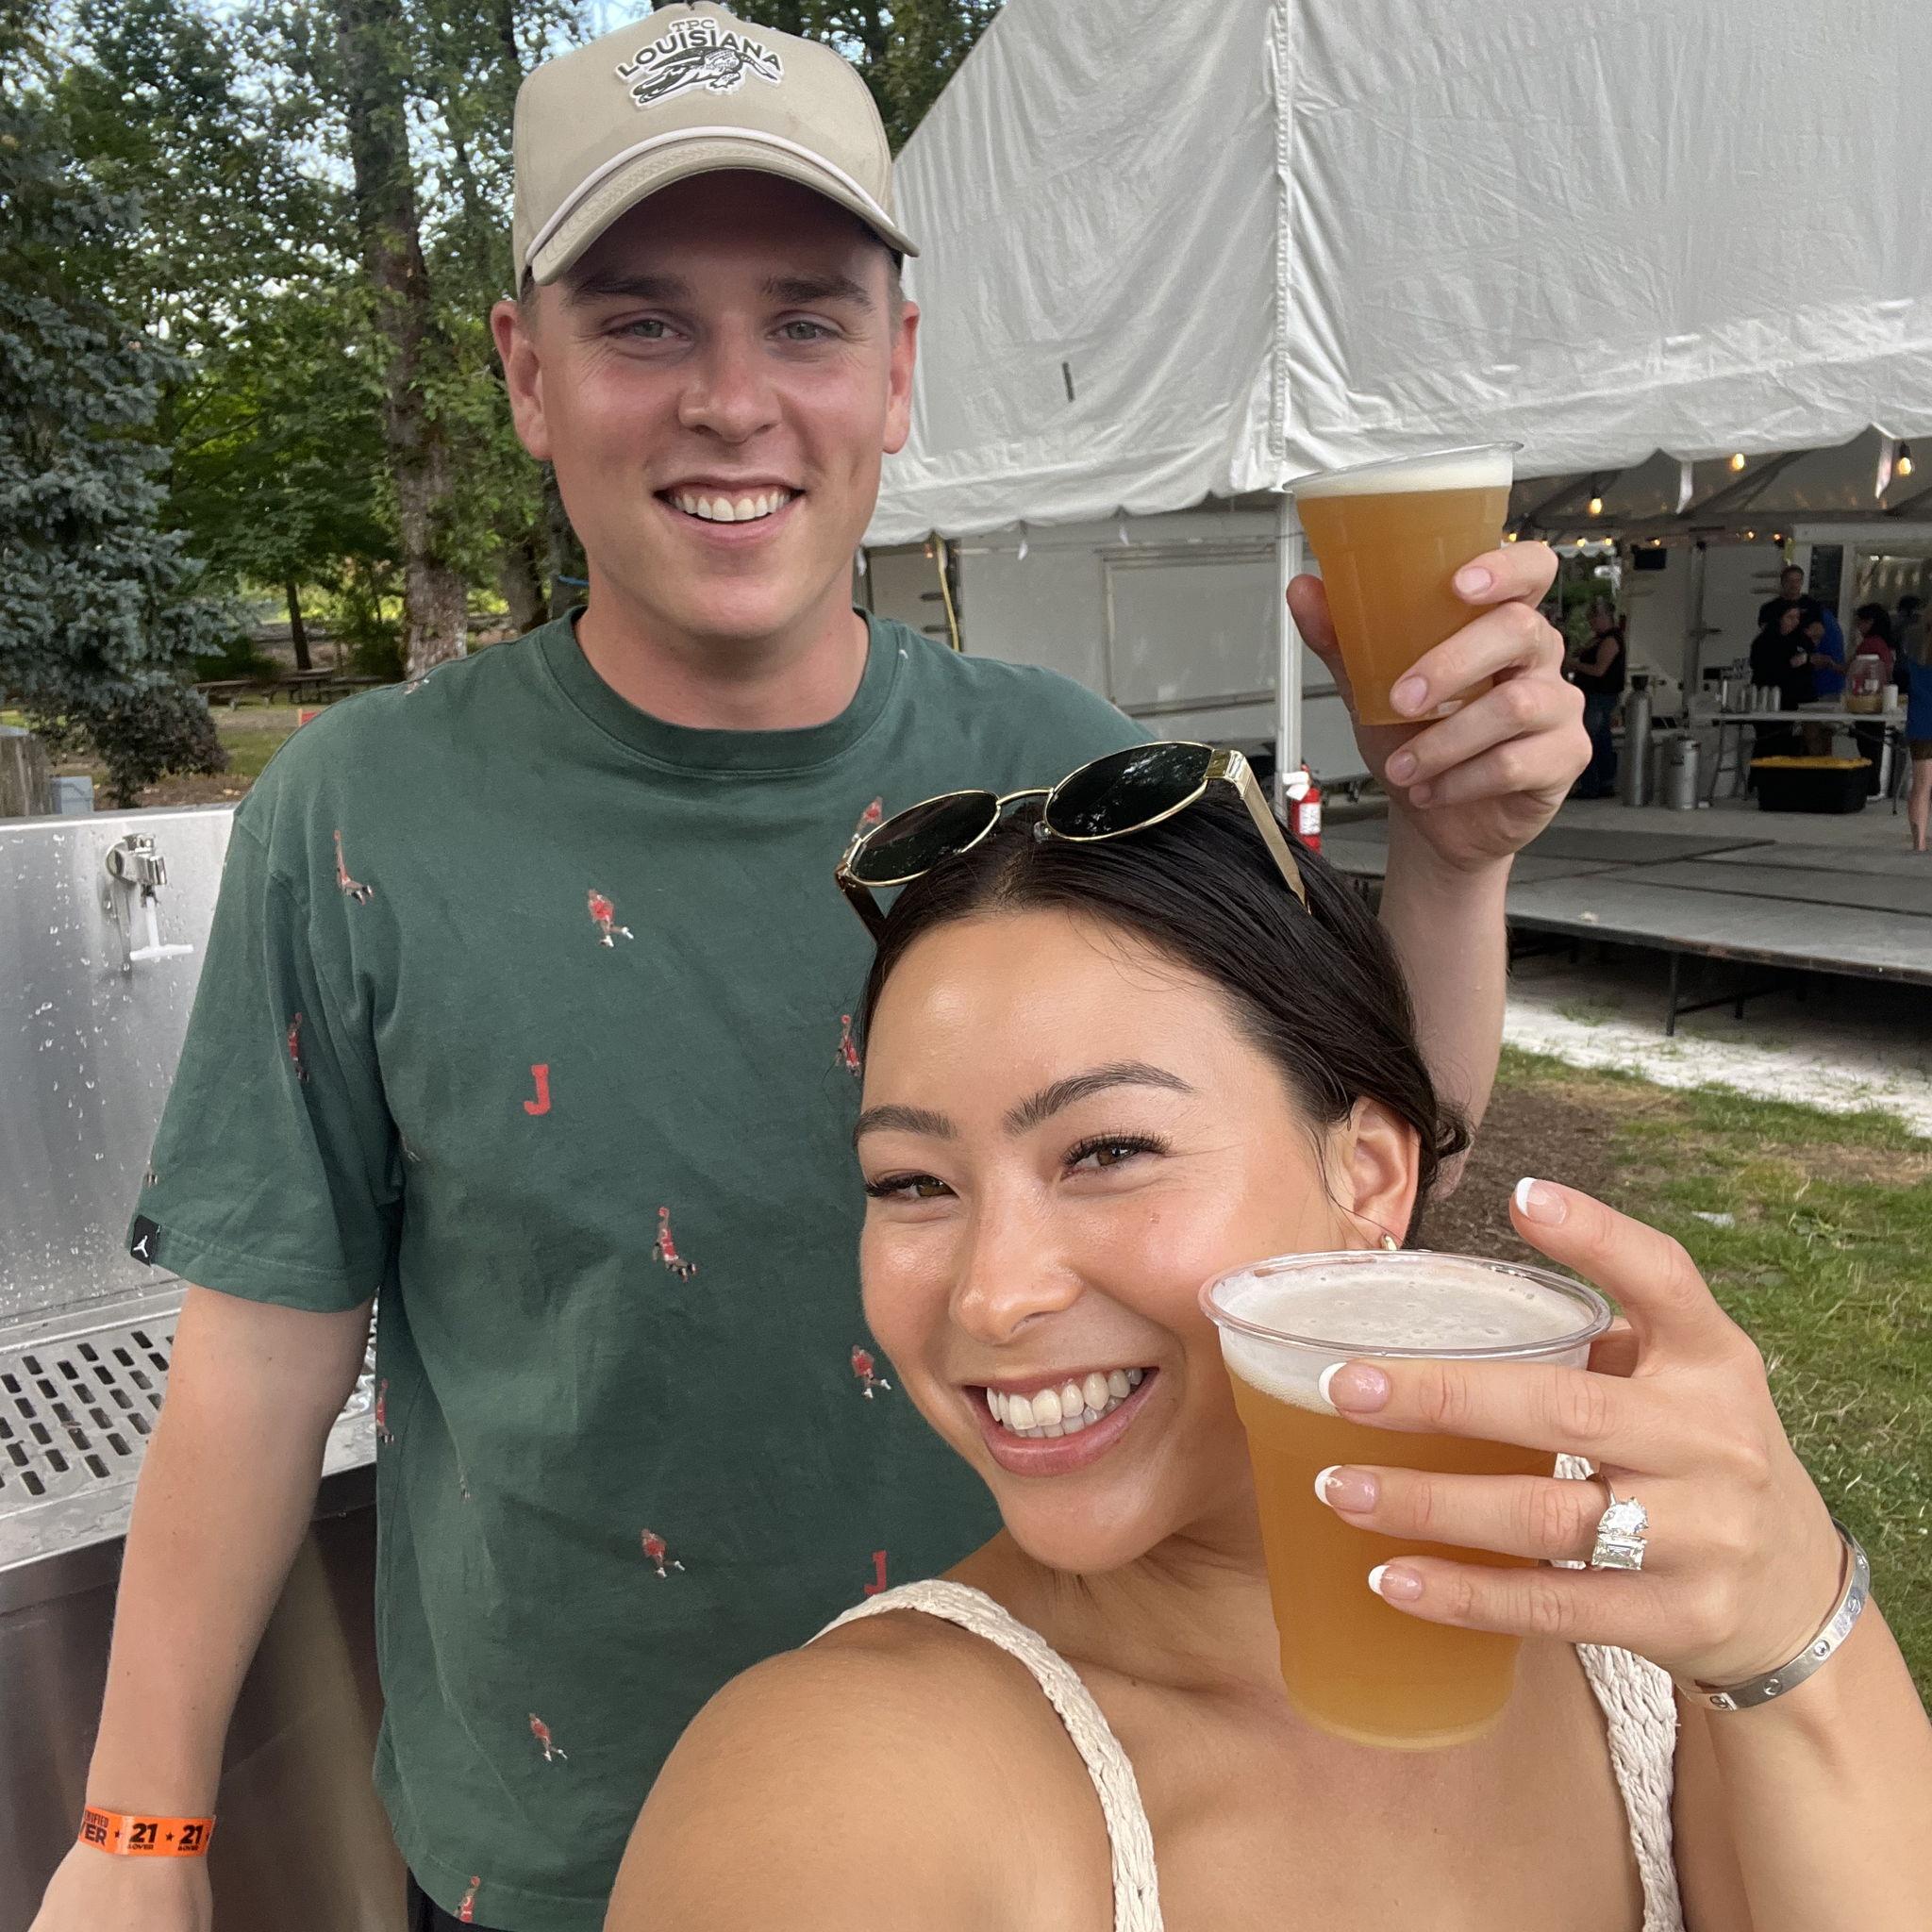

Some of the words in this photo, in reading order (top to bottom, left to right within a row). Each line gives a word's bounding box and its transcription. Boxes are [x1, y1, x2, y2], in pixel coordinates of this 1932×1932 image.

[672, 19, 715, 32] TPC
[617, 29, 781, 77] LOUISIANA
[523, 1063, 551, 1116] J
[863, 1549, 887, 1596] J
[128, 1823, 158, 1843] 21
[179, 1824, 204, 1845] 21
